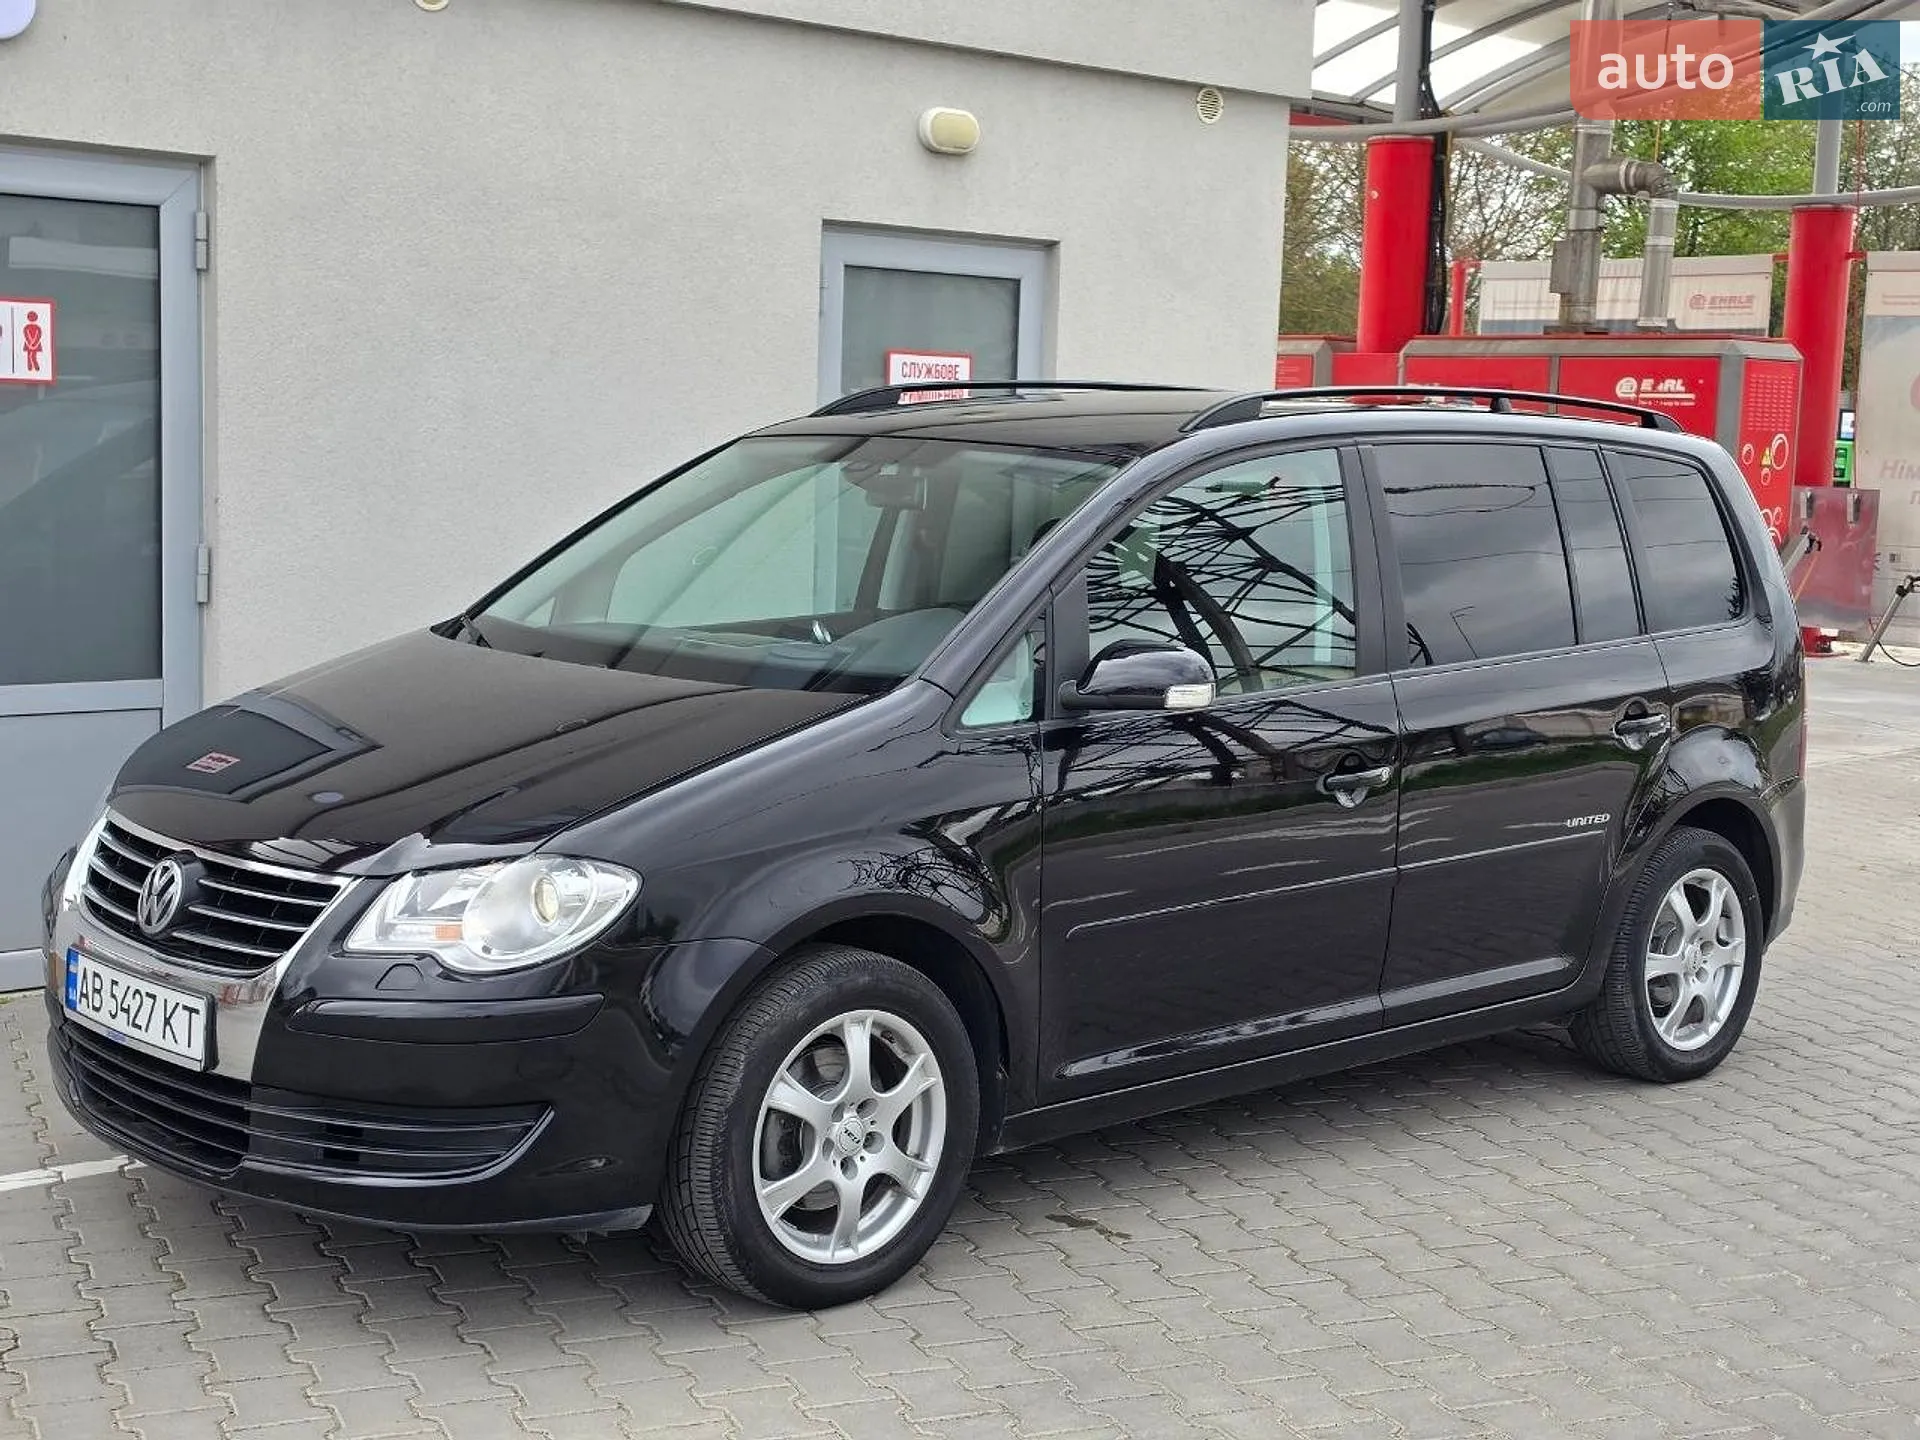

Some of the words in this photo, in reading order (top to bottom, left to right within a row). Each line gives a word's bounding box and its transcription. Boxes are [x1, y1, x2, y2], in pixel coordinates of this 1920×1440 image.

[901, 361, 960, 380] СЛУЖБОВЕ
[1567, 813, 1611, 828] UNITED
[79, 967, 104, 1013] AB
[109, 979, 157, 1033] 5427
[162, 998, 200, 1048] KT
